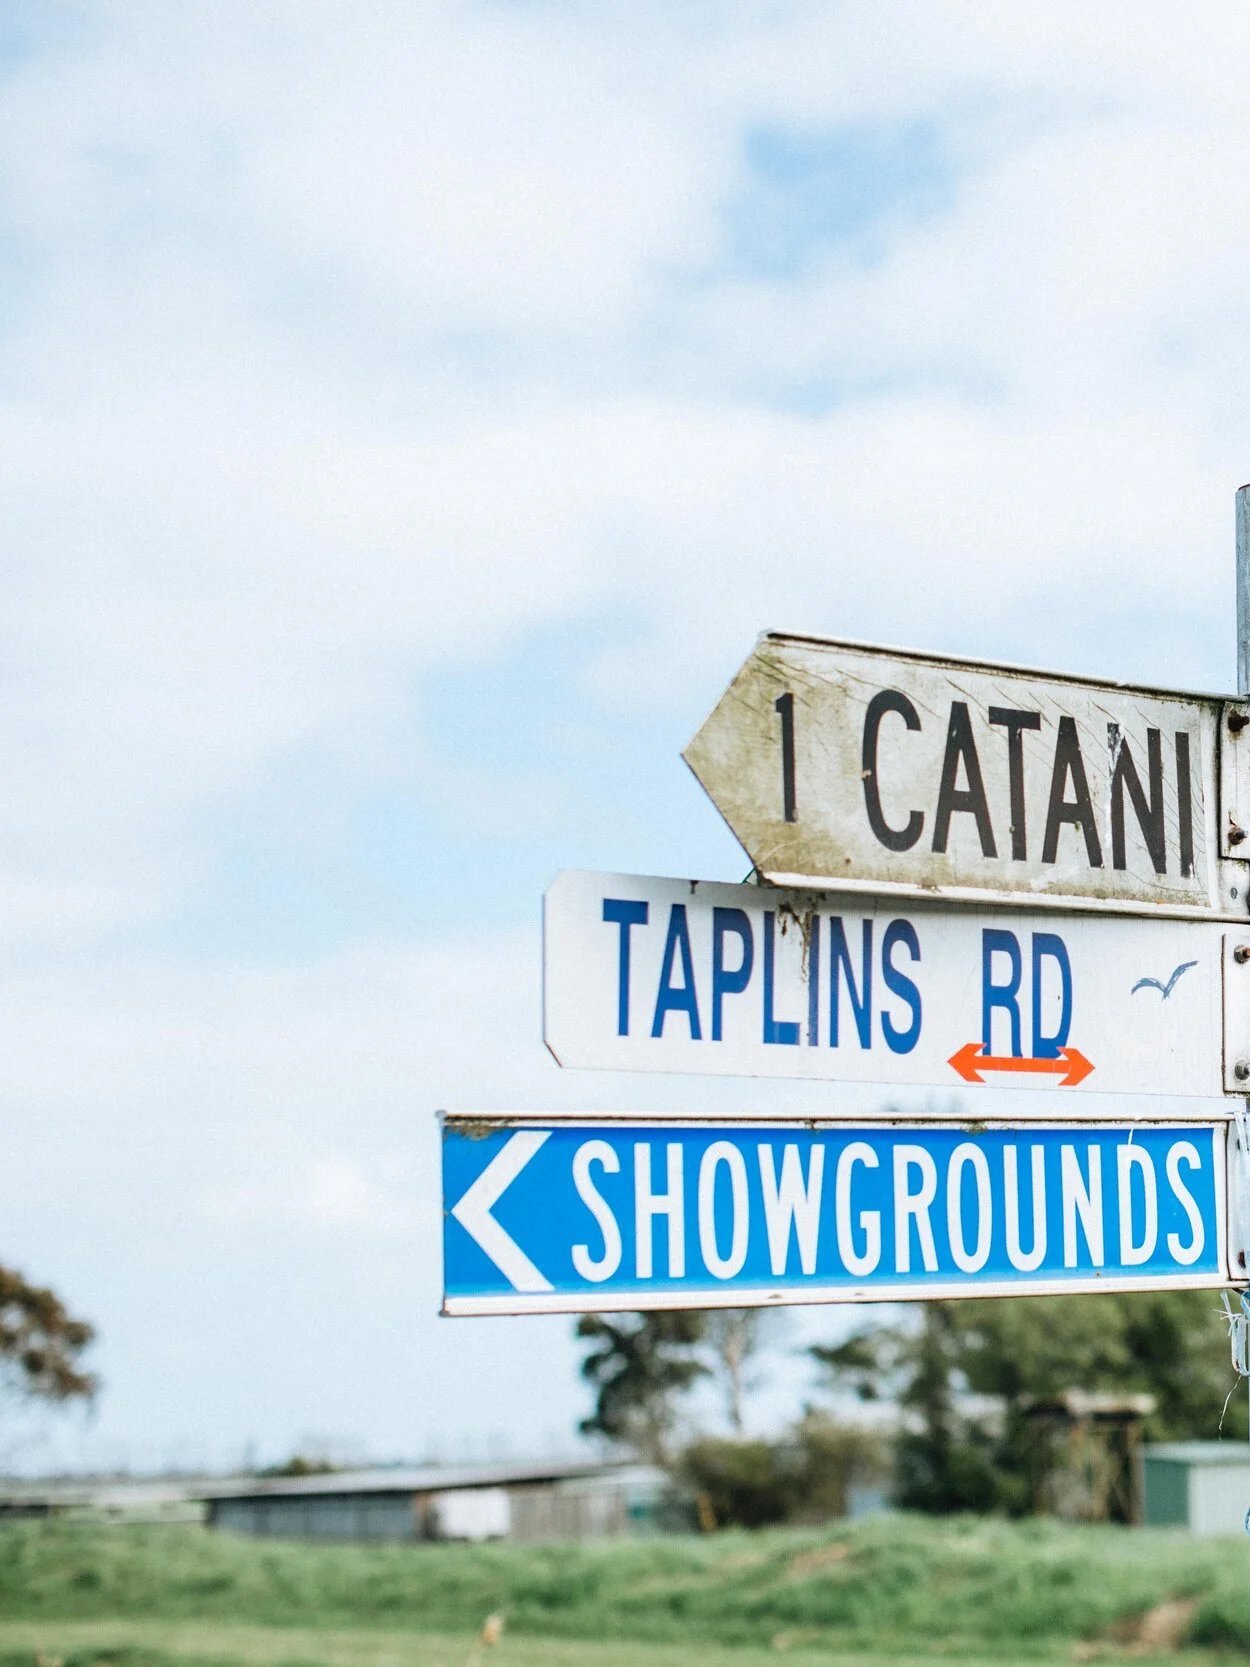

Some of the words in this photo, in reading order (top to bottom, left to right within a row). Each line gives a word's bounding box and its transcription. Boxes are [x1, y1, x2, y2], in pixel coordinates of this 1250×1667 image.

[775, 692, 797, 822] 1
[861, 689, 1191, 878] CATANI
[603, 898, 922, 1055] TAPLINS
[981, 928, 1073, 1060] RD
[571, 1139, 1206, 1283] SHOWGROUNDS
